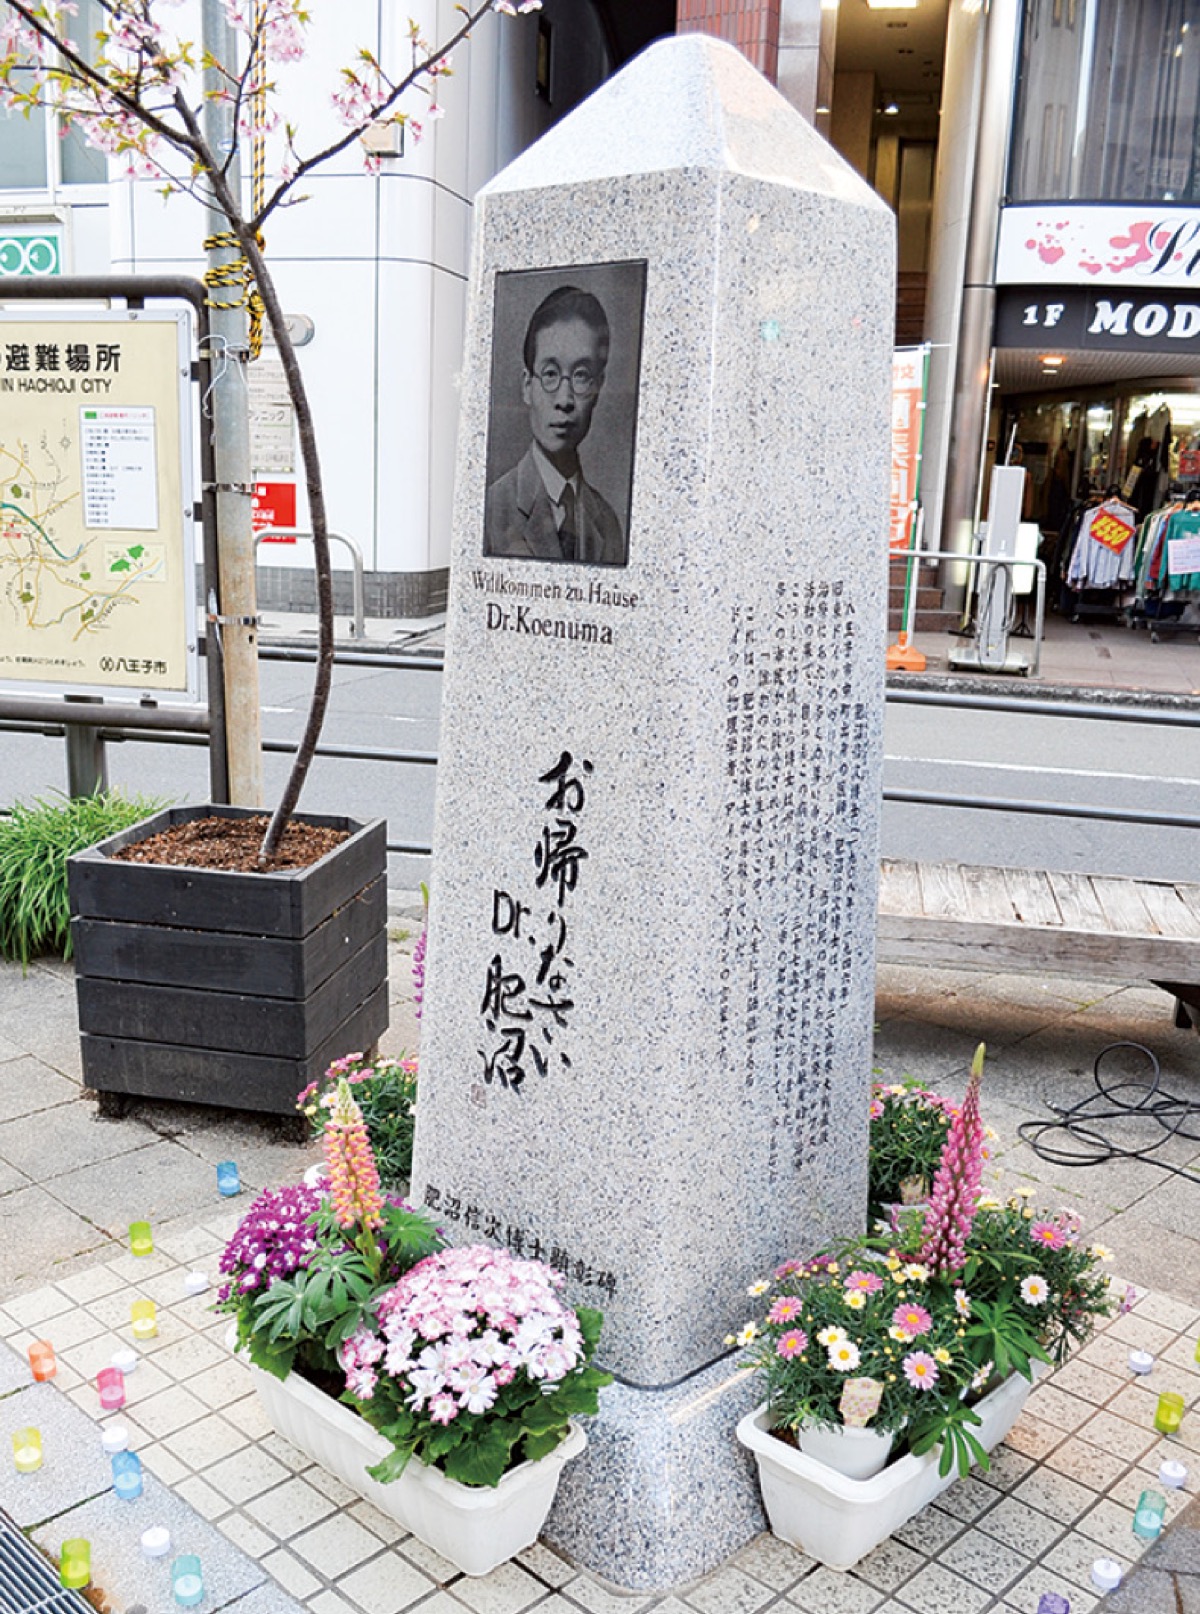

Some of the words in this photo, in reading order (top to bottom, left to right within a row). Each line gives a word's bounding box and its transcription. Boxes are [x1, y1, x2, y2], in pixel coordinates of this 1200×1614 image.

[1022, 303, 1064, 327] 1F
[0, 343, 121, 373] 避難場所
[18, 378, 76, 393] HACHIOJI
[81, 378, 112, 393] CITY
[472, 571, 561, 599] Willkommen
[565, 586, 583, 600] zu
[588, 582, 639, 608] Hause
[486, 602, 613, 645] Dr.Koenuma
[115, 656, 168, 675] 八王子市
[528, 750, 594, 1078] お帰りなさい
